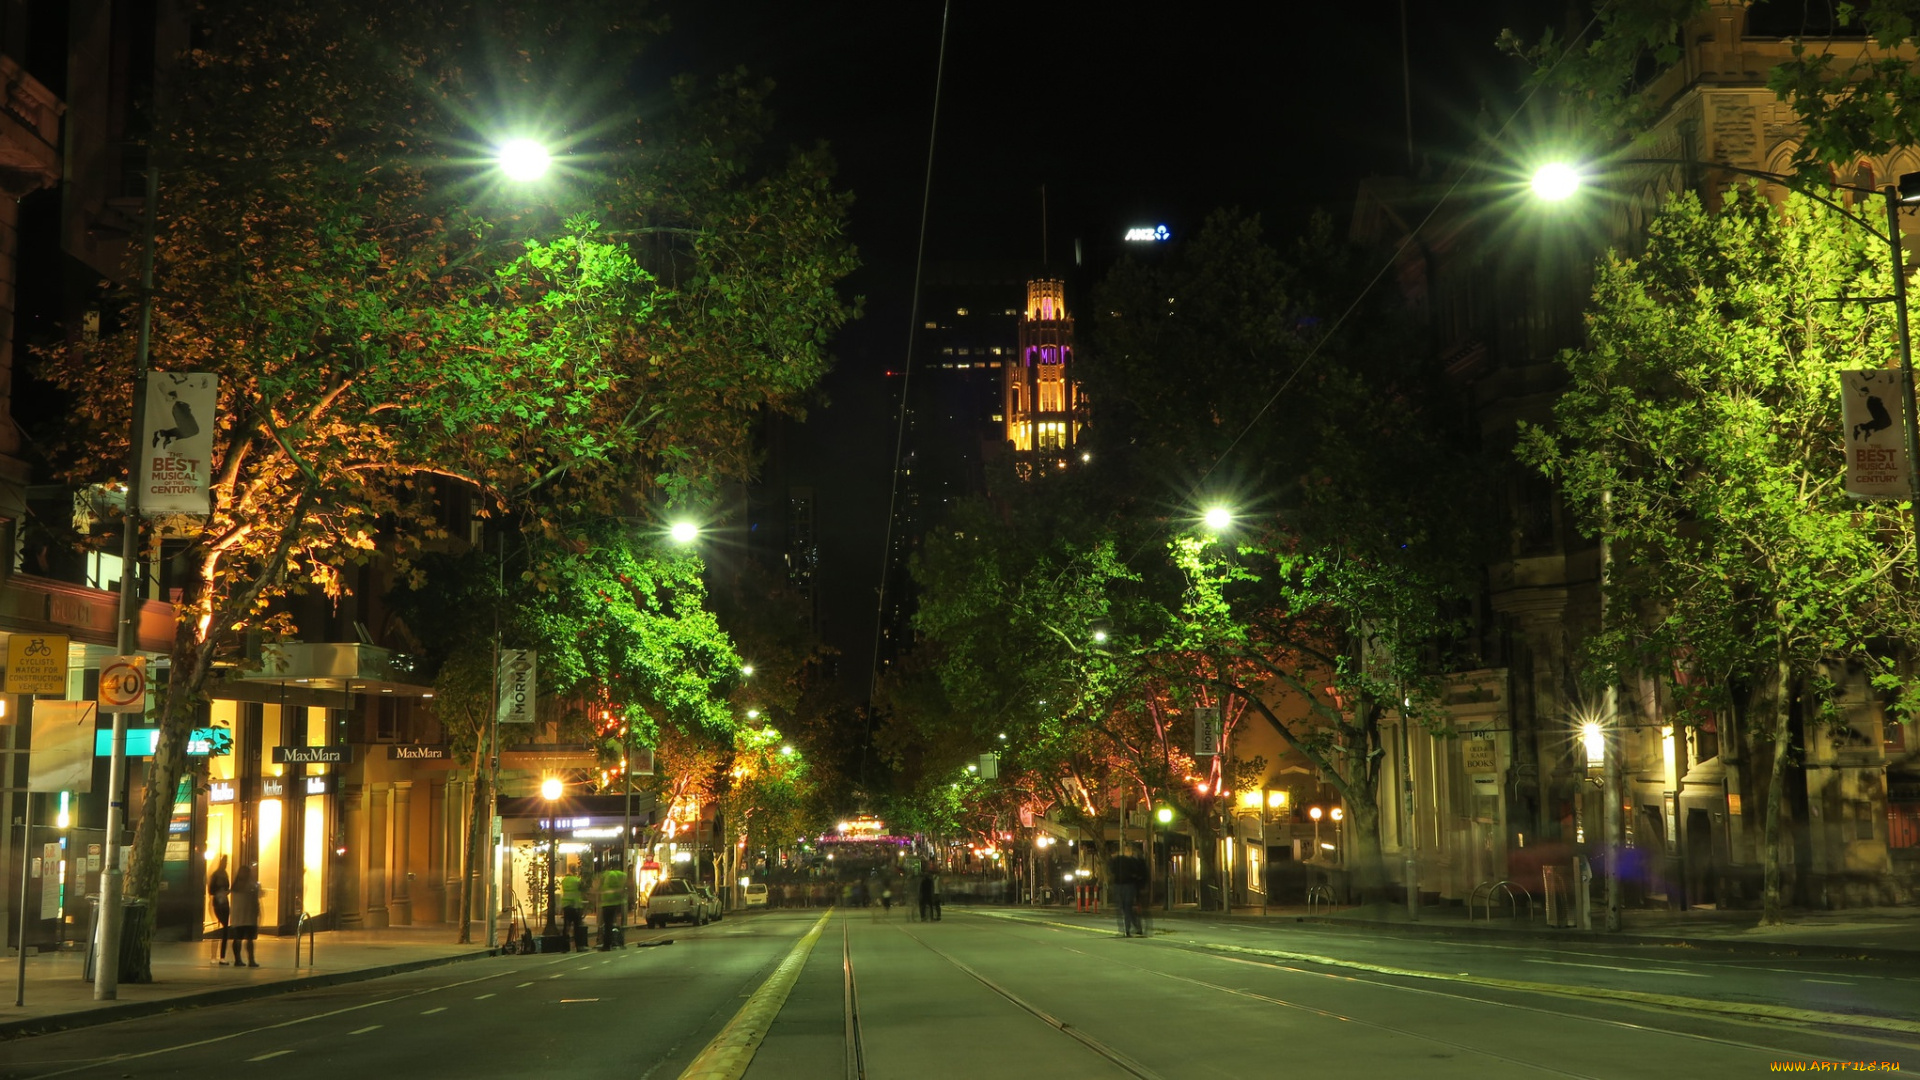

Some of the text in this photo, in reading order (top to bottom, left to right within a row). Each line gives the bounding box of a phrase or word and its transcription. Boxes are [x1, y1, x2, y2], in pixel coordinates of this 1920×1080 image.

[1125, 228, 1155, 240] ANZ
[1856, 449, 1897, 462] BEST
[152, 458, 200, 473] BEST
[1856, 462, 1898, 470] MUSICAL
[152, 472, 198, 481] MUSICAL
[1856, 475, 1898, 483] CENTURY
[151, 485, 198, 494] CENTURY
[9, 674, 63, 682] CONSTRUCTION
[107, 674, 138, 694] 40
[284, 748, 340, 761] MaxMara
[396, 747, 442, 759] MaxMara
